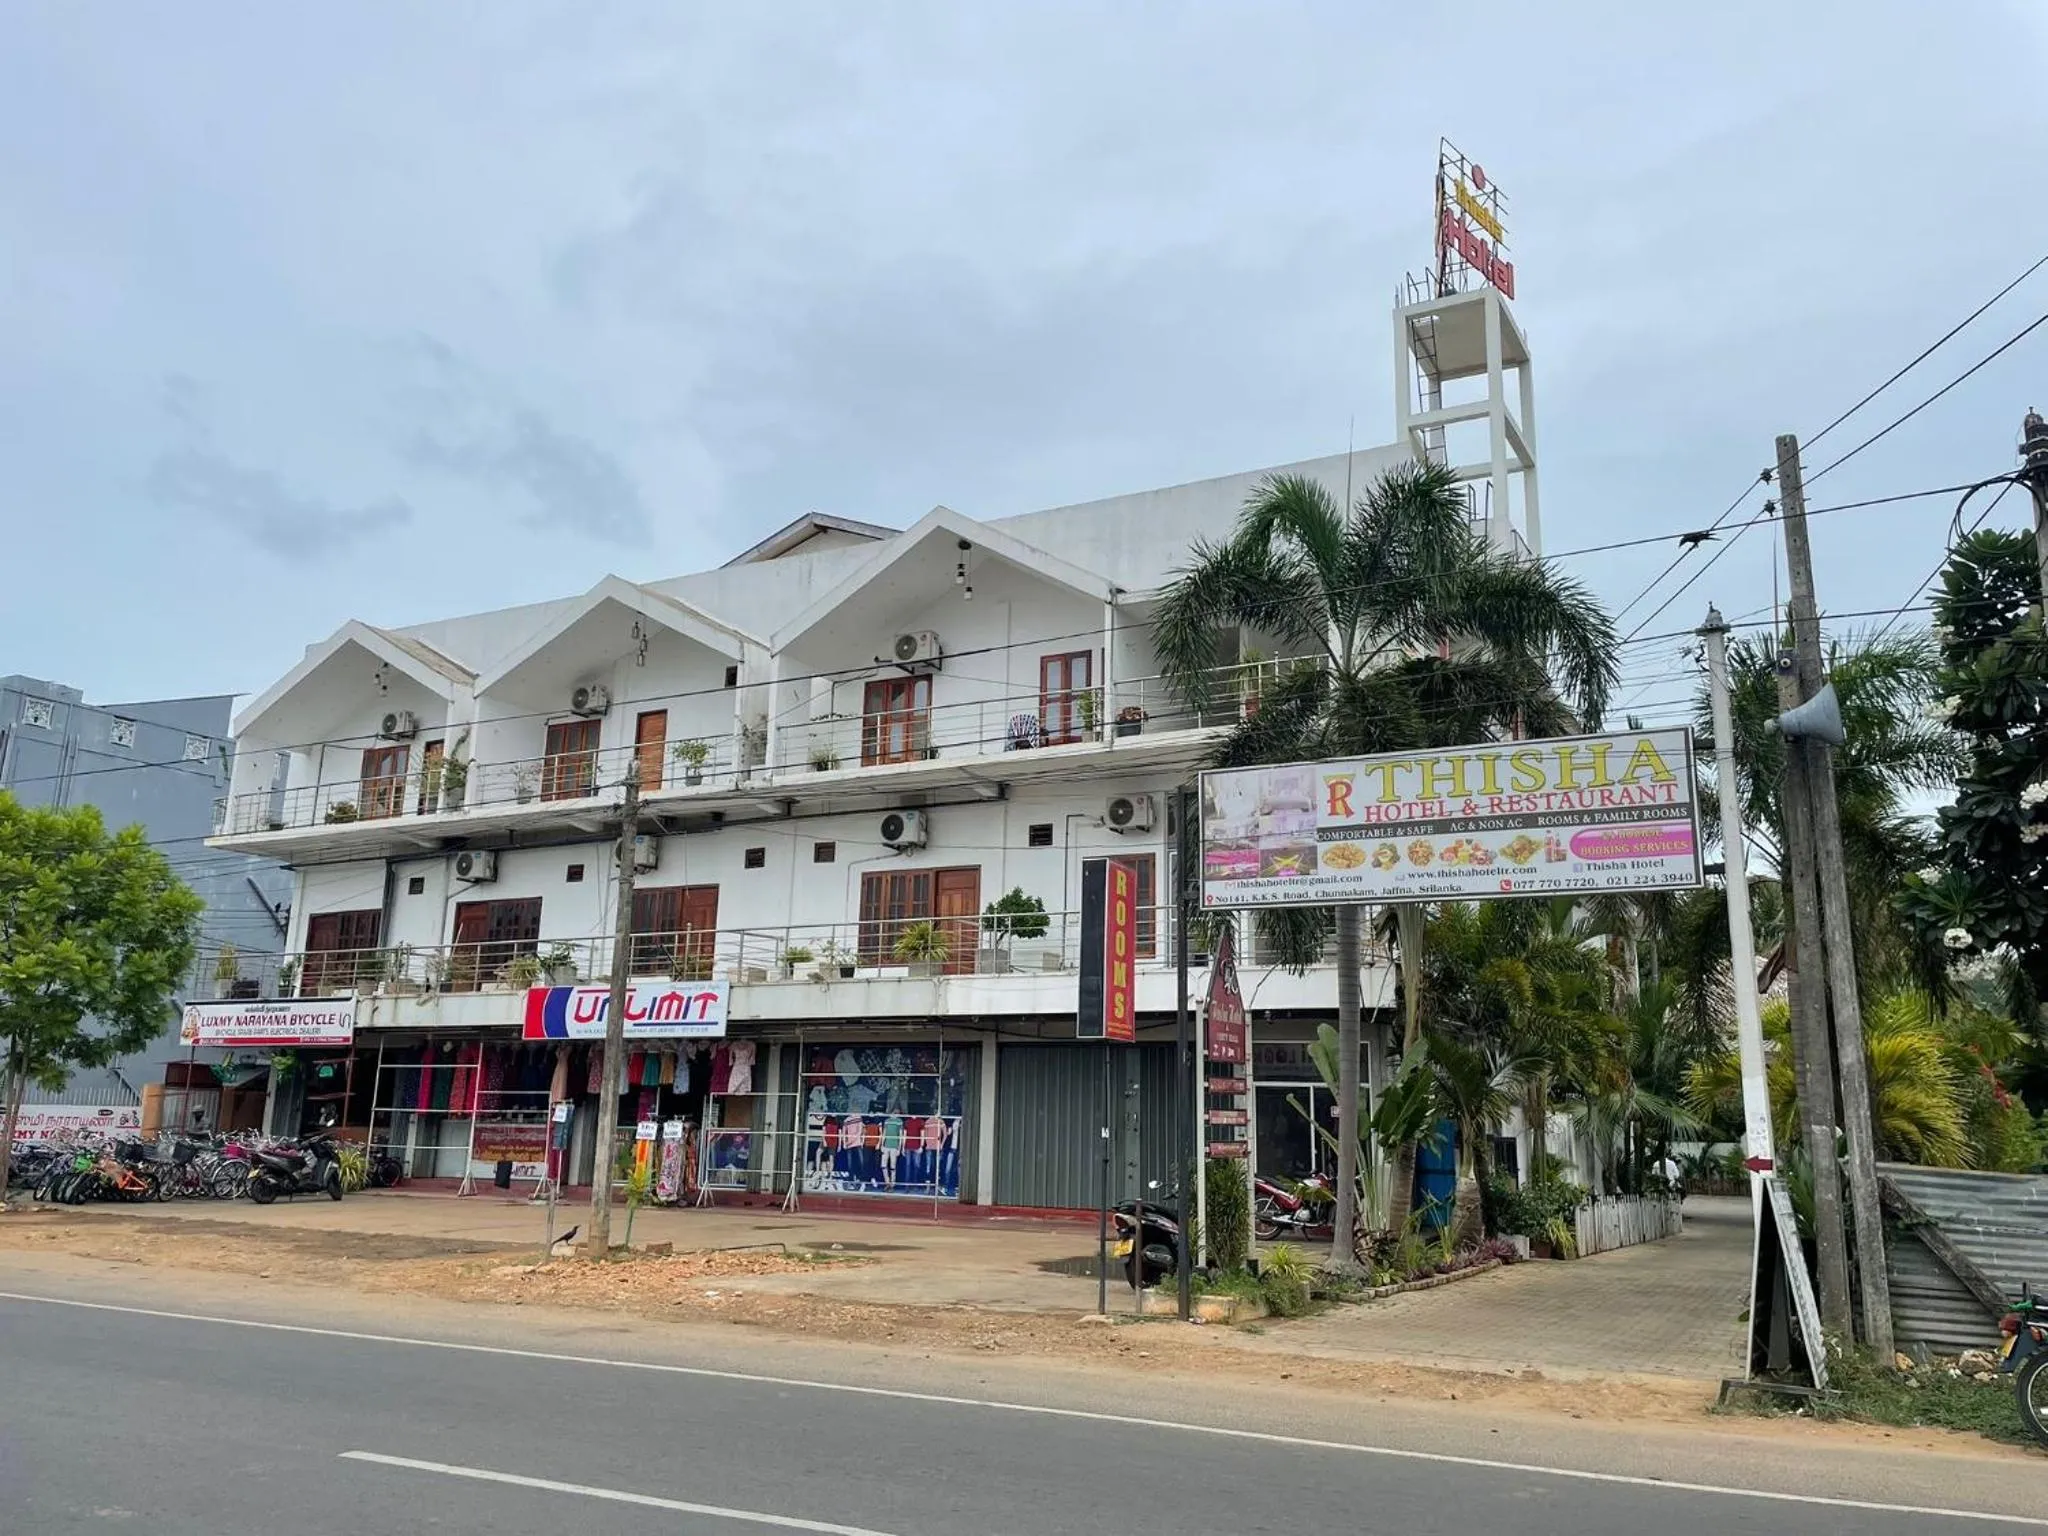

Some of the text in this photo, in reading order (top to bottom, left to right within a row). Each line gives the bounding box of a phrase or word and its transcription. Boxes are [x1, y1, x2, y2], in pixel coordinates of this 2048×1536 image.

[1443, 207, 1515, 300] Hotel
[1365, 739, 1677, 803] THISHA
[1365, 783, 1678, 822] HOTEL & RESTAURANT
[1317, 807, 1687, 841] COMFORTABLE & SAFE AC & NON AC ROOMS & FAMILY ROOMS
[1633, 840, 1688, 852] SERVICES
[1514, 879, 1535, 889] 077
[1539, 878, 1562, 889] 770
[1606, 876, 1628, 886] 021
[1661, 873, 1693, 883] 3940
[1586, 858, 1664, 872] Thisha Hotel
[1113, 870, 1127, 1019] ROOMS
[201, 1012, 335, 1028] LUXMY NARAYANA BYCYCLE
